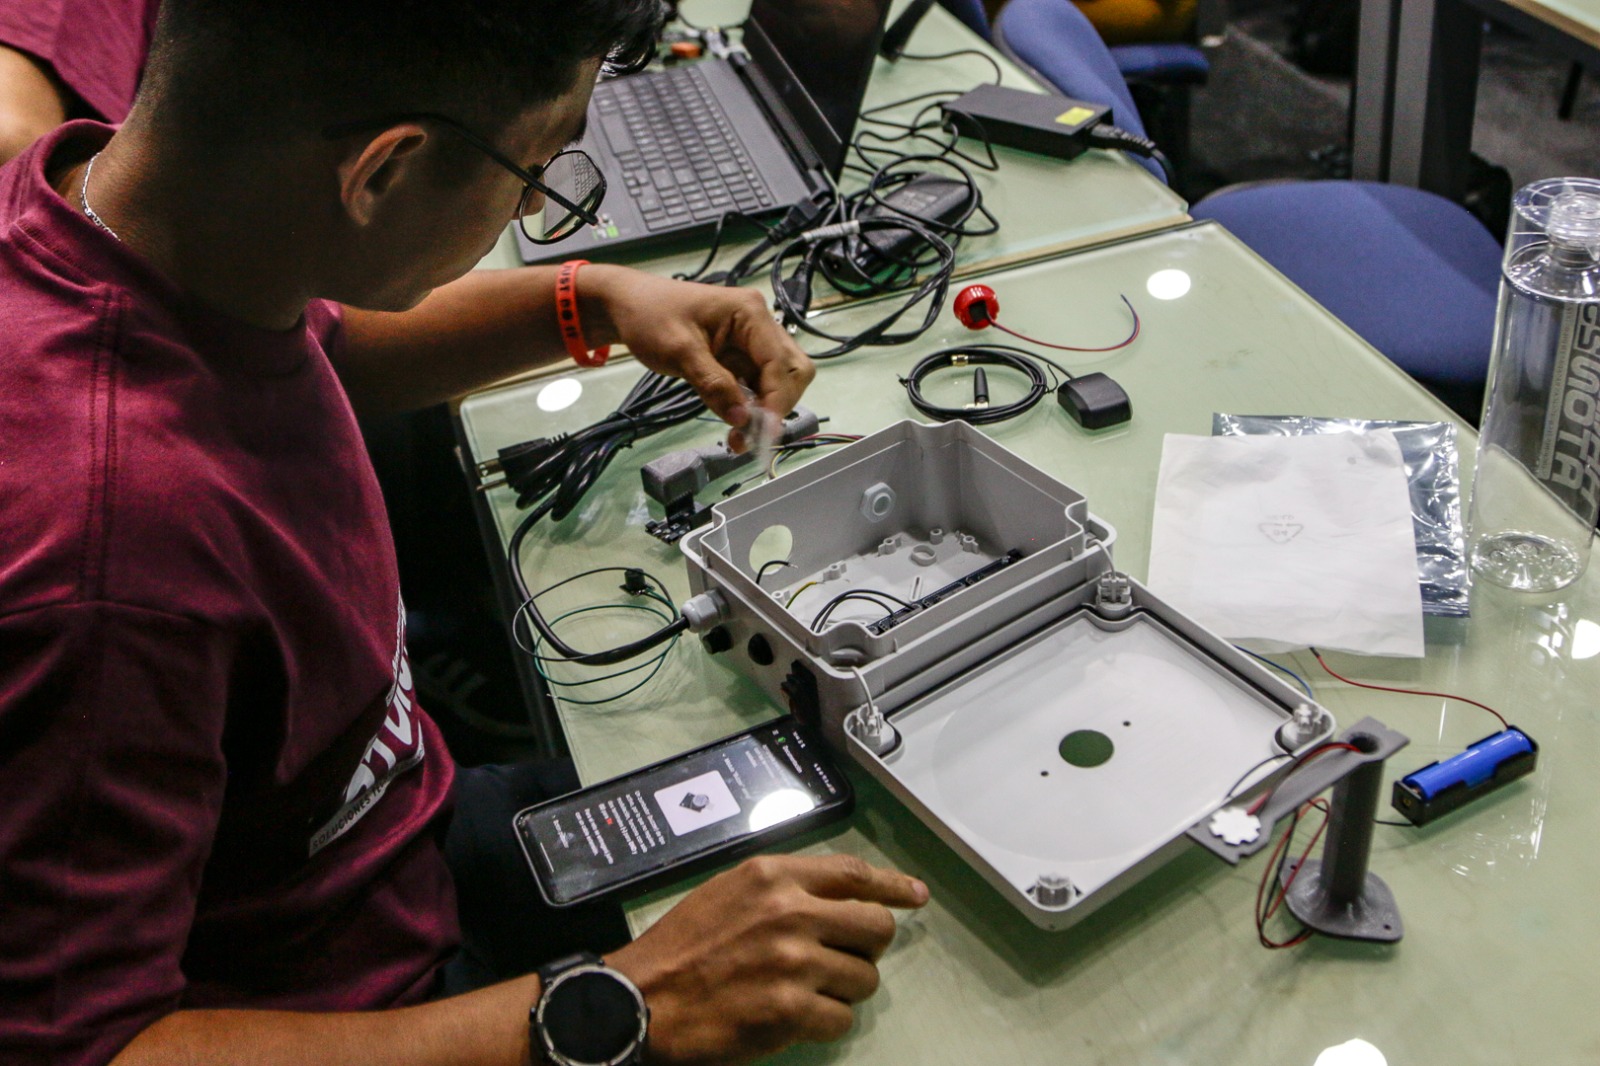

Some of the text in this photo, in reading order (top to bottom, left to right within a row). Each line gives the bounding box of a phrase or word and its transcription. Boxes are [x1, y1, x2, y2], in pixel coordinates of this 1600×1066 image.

[560, 265, 573, 291] JUST
[560, 299, 573, 320] DO
[311, 797, 373, 851] SOLUCIONES
